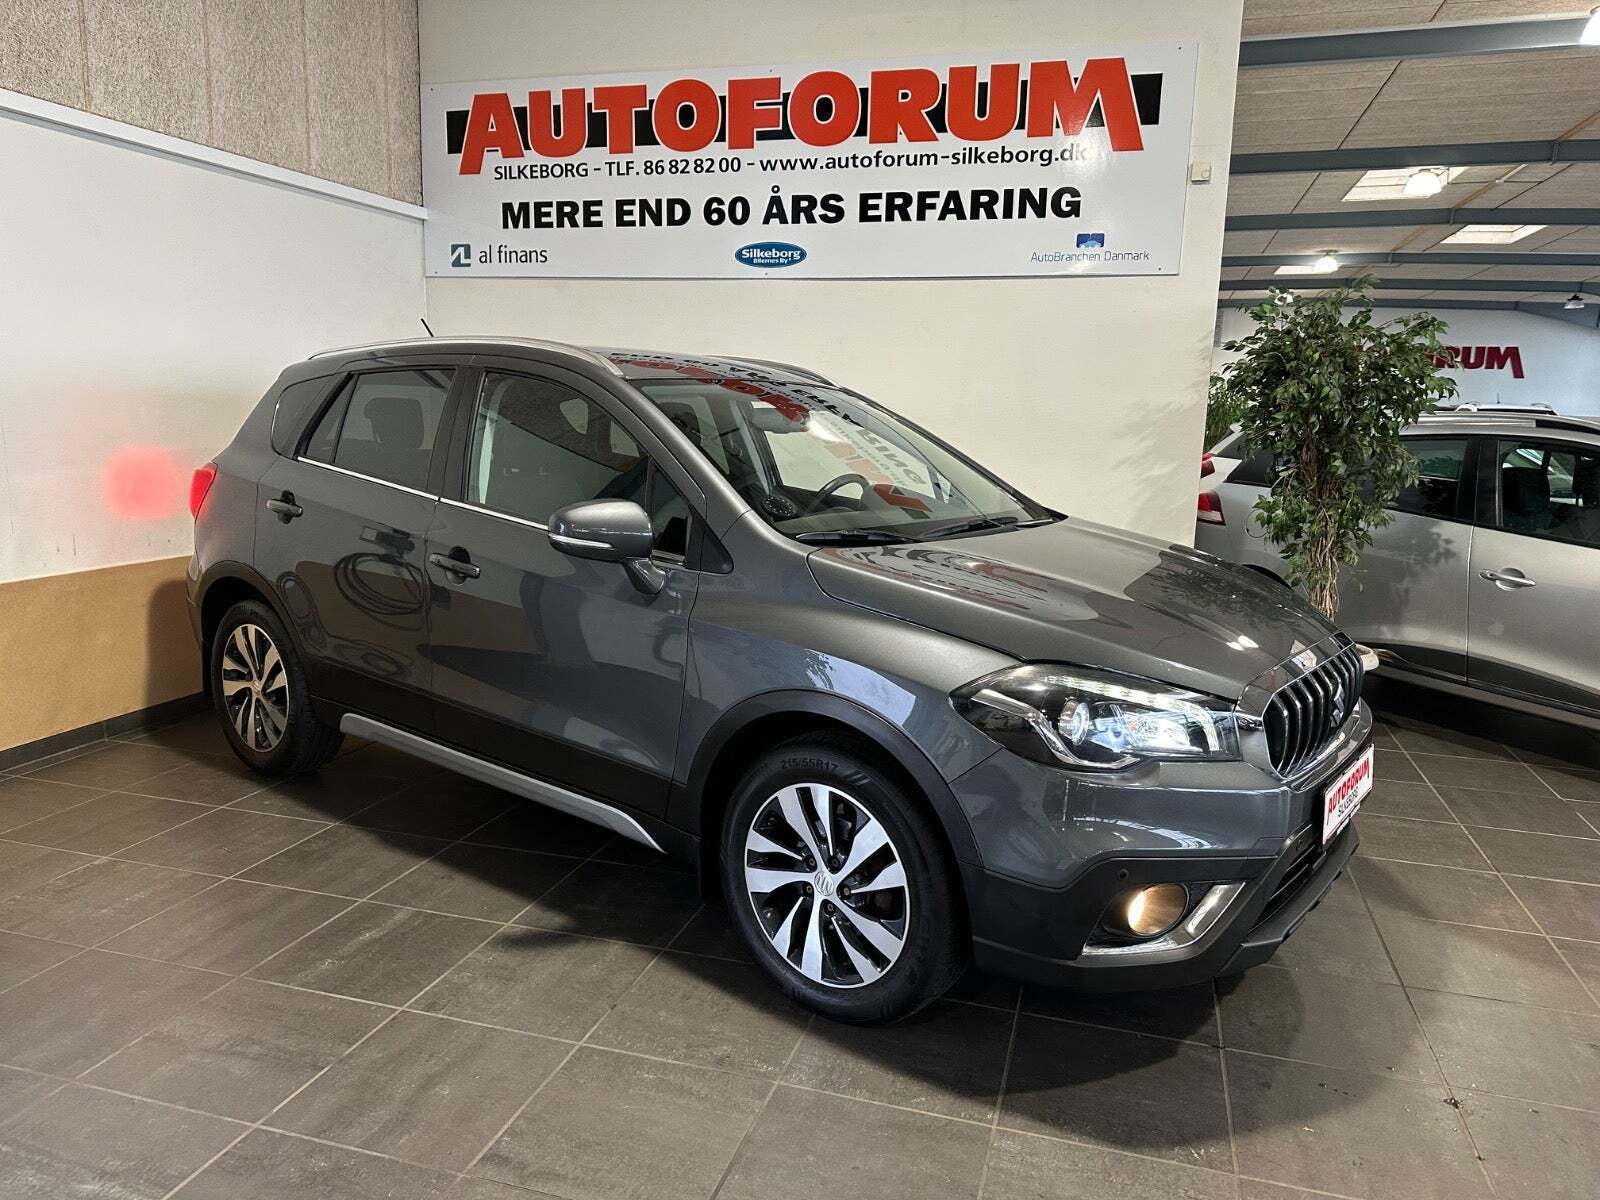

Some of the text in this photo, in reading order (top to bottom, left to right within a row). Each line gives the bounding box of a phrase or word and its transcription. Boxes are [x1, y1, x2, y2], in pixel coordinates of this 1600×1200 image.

[459, 56, 1145, 176] AUTOFORUM
[494, 162, 589, 181] SILKEBORG
[605, 160, 640, 177] TLF.
[759, 142, 1087, 172] www.autoforum-silkeborg.dk
[501, 185, 1082, 230] MERE END 60 ÅRS ERFARING
[479, 244, 548, 263] al finans
[742, 248, 800, 260] Silkeborg
[1031, 250, 1150, 262] AutoBranchen Danmark
[1327, 757, 1371, 826] AUTOFORUM
